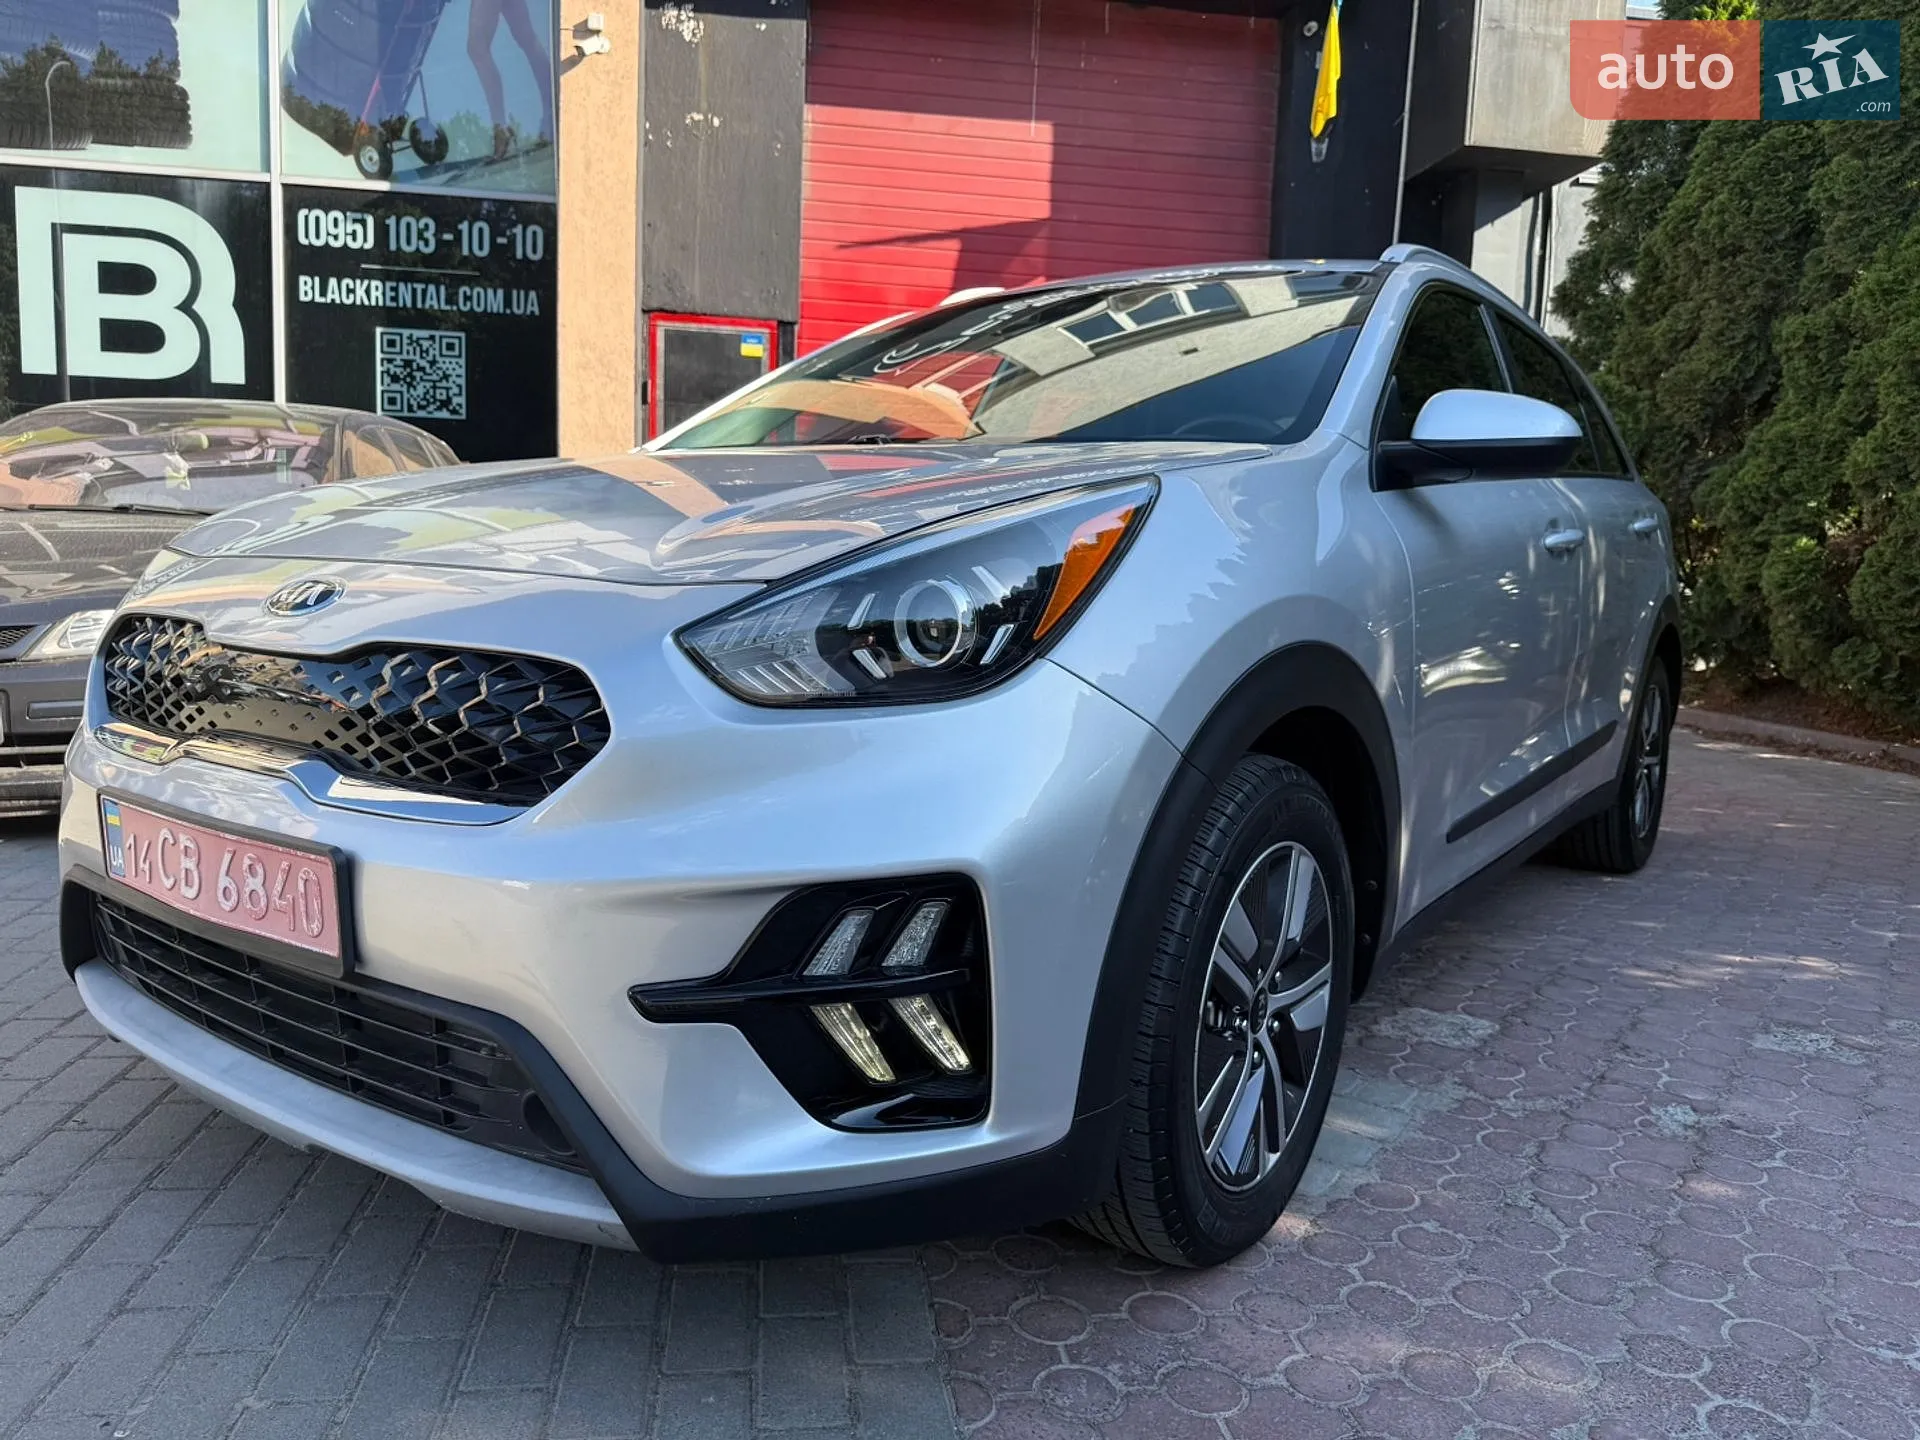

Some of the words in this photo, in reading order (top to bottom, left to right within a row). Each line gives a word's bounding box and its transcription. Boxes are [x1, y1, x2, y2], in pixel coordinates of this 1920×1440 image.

[297, 208, 375, 250] (095)
[298, 275, 540, 316] BLACKRENTAL.COM.UA
[109, 845, 125, 870] UA
[215, 848, 325, 938] 6840
